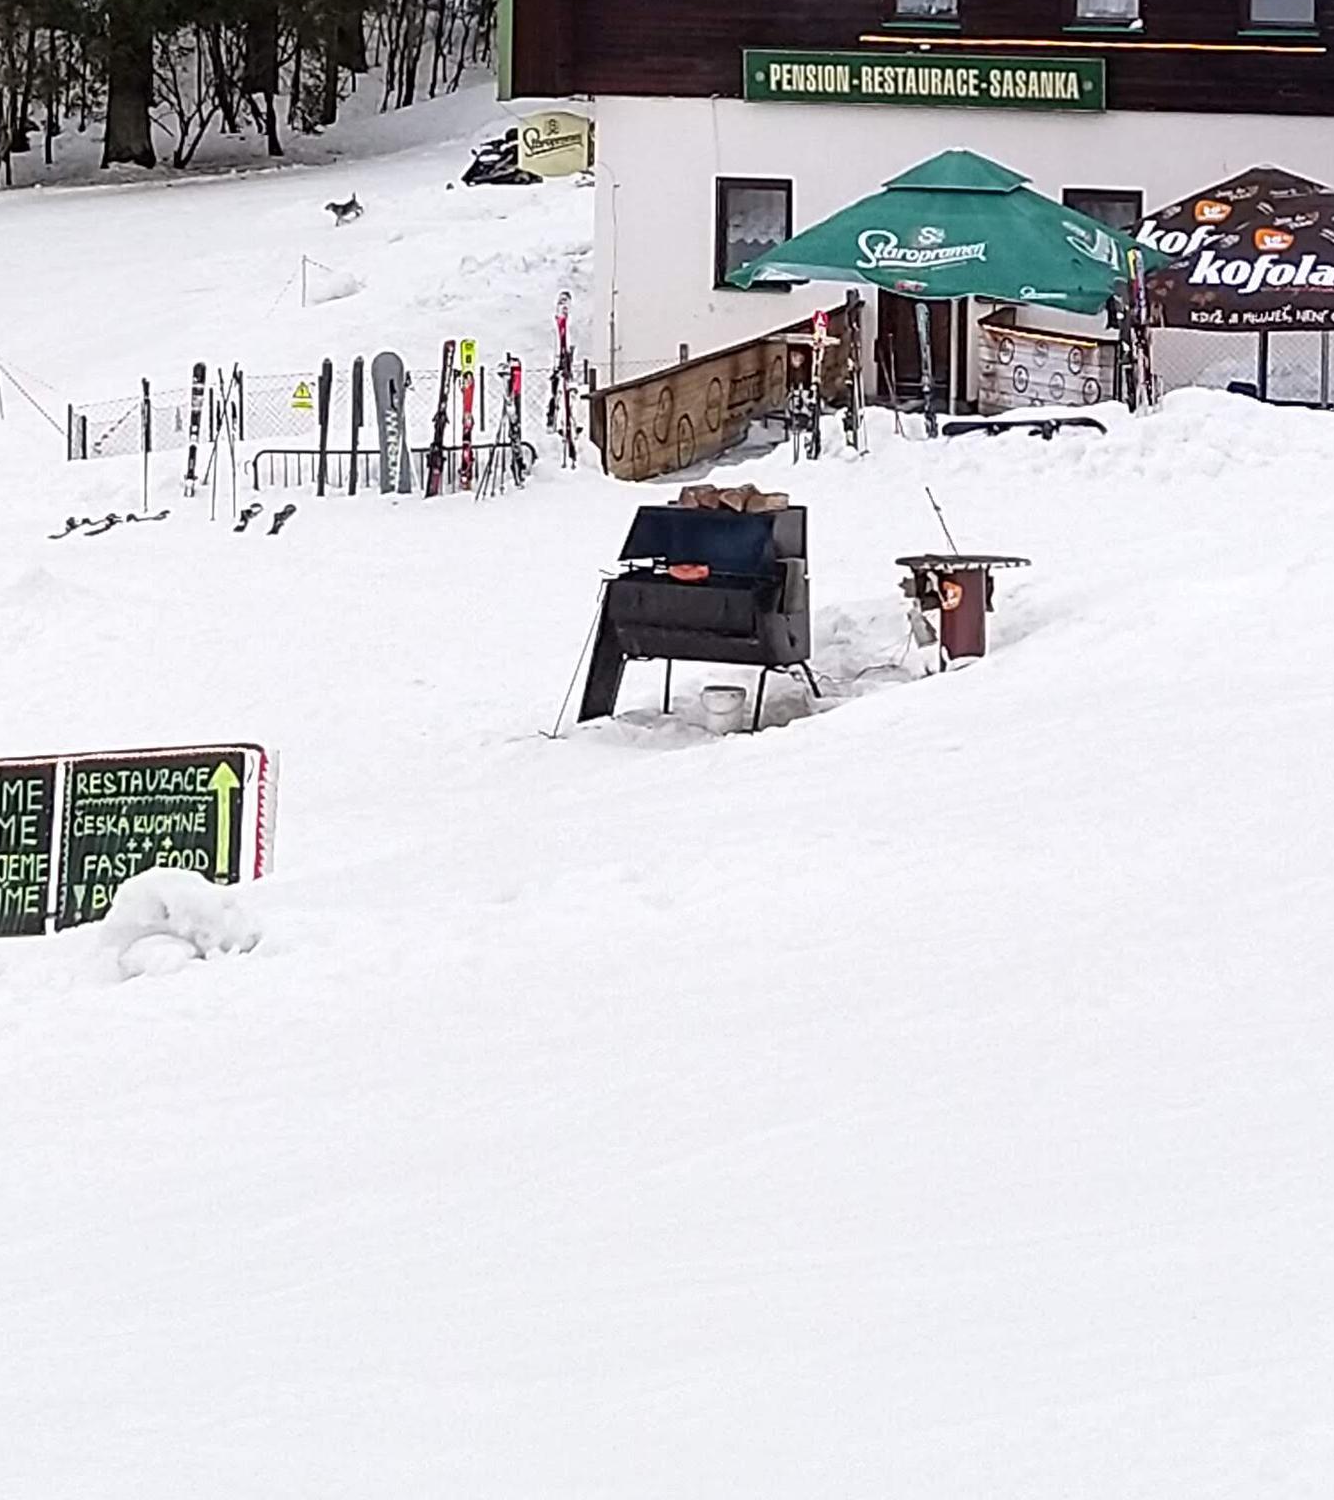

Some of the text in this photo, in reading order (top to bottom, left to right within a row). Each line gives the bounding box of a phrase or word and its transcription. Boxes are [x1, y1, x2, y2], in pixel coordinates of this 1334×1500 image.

[856, 229, 987, 270] Staropramen
[76, 766, 211, 796] RESTAURACE
[73, 806, 130, 837] ČESKÁ
[83, 848, 210, 881] FAST FOOD
